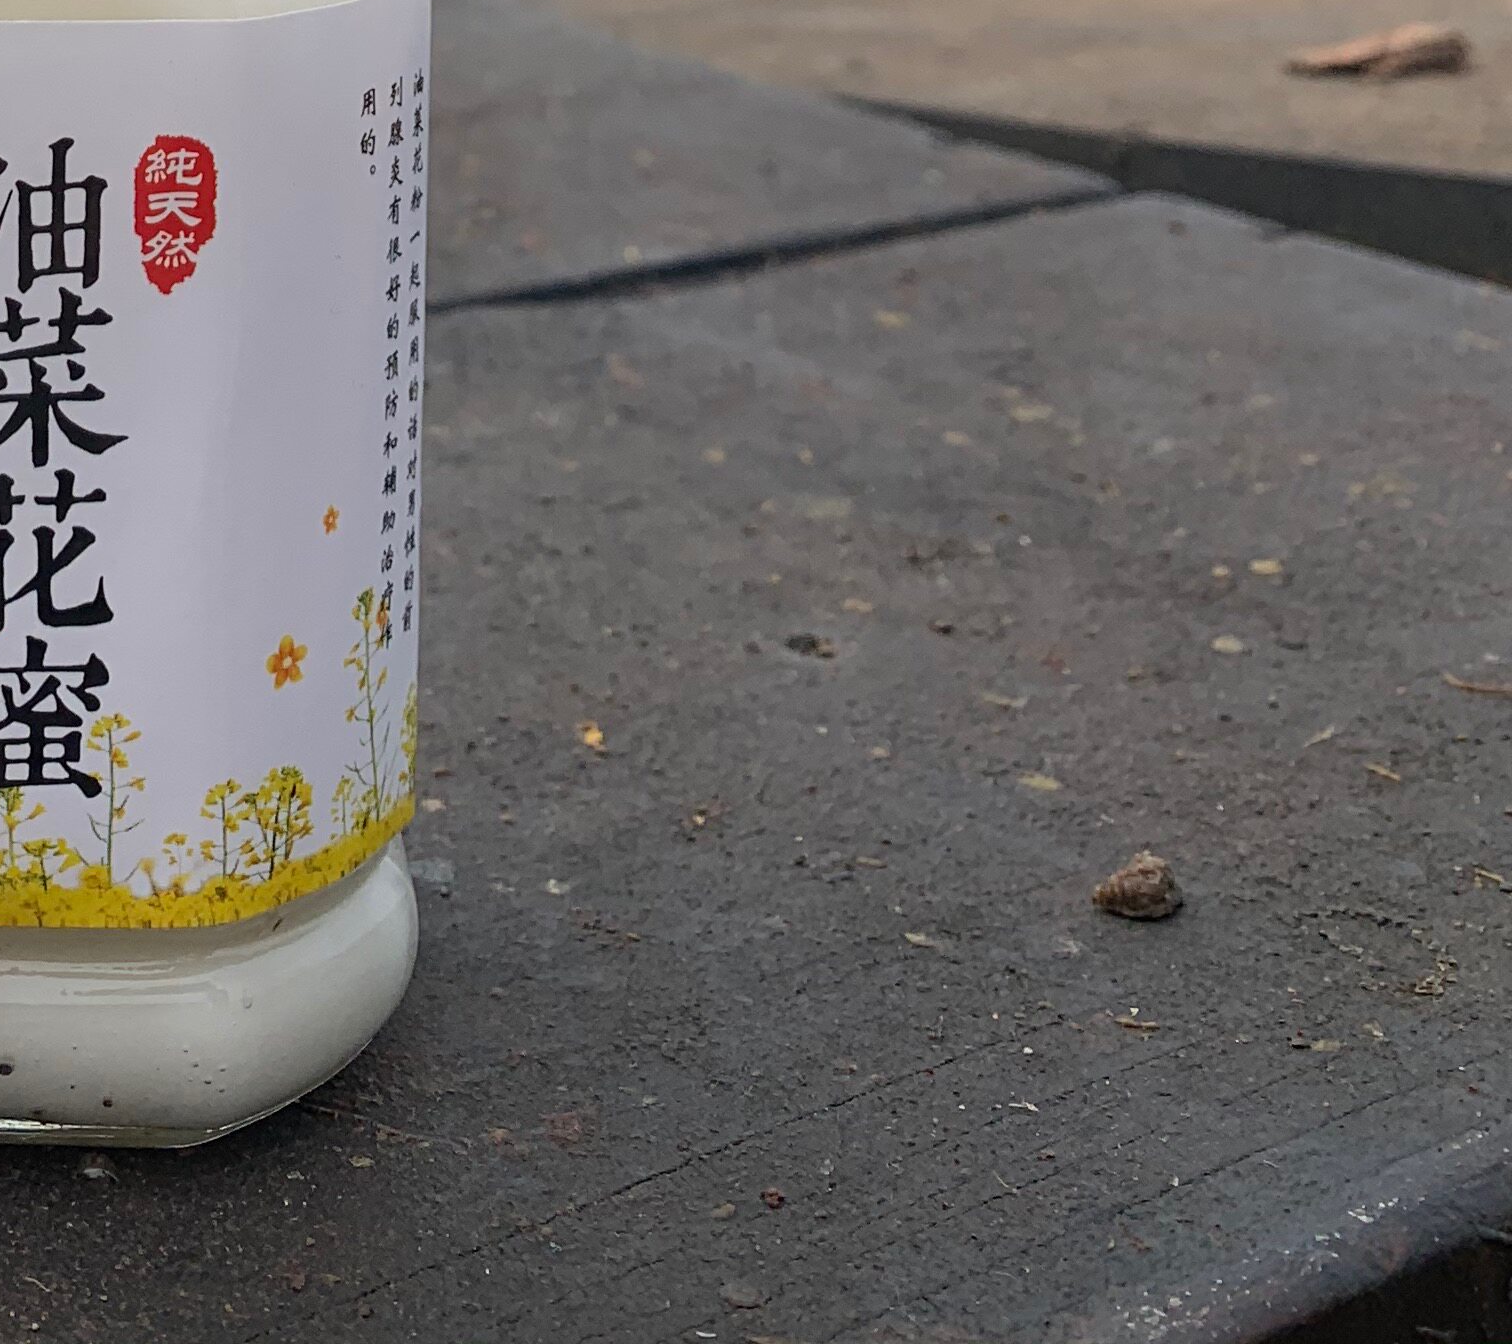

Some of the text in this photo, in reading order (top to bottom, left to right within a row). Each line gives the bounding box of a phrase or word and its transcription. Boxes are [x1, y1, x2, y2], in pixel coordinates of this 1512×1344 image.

[360, 87, 377, 176] 用的。
[141, 148, 203, 269] 純天然
